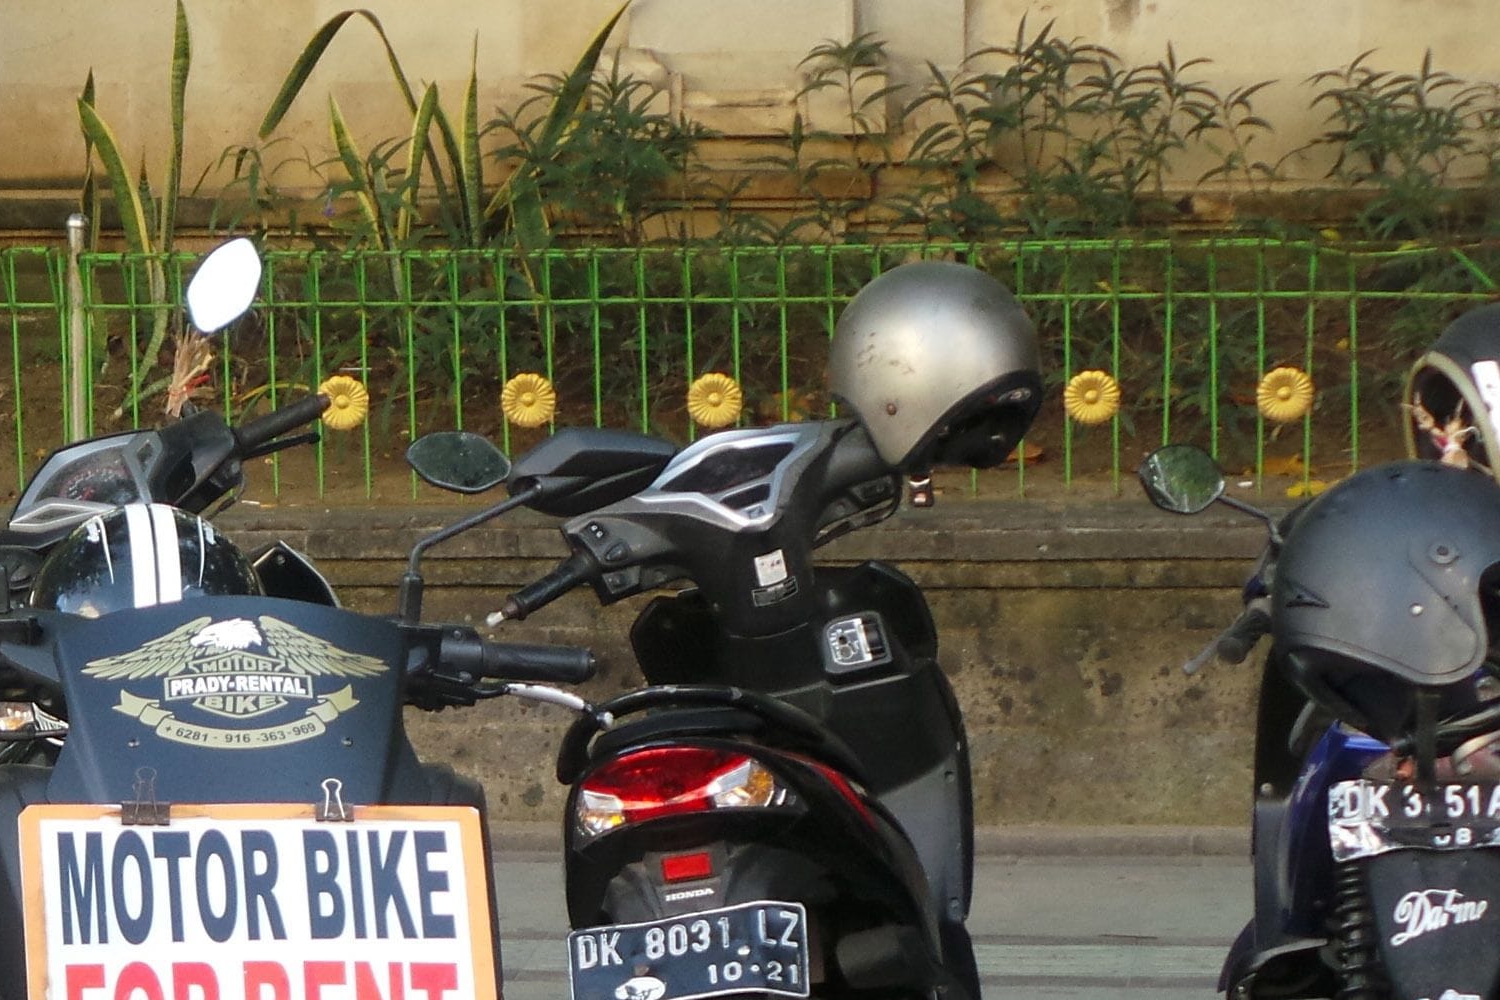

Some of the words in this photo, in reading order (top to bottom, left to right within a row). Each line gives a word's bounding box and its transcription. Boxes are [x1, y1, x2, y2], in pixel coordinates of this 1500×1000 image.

[202, 654, 273, 672] MOTOR
[170, 675, 307, 697] PRADY-RENTAL
[204, 695, 277, 714] BIKE
[176, 727, 209, 742] 6281
[225, 733, 251, 743] 916
[1344, 784, 1390, 817] DK
[57, 829, 288, 945] MOTOR
[302, 829, 457, 940] BIKE
[665, 888, 714, 902] HONDA
[577, 930, 623, 970] DK
[645, 916, 730, 960] 8031
[757, 909, 799, 948] LZ
